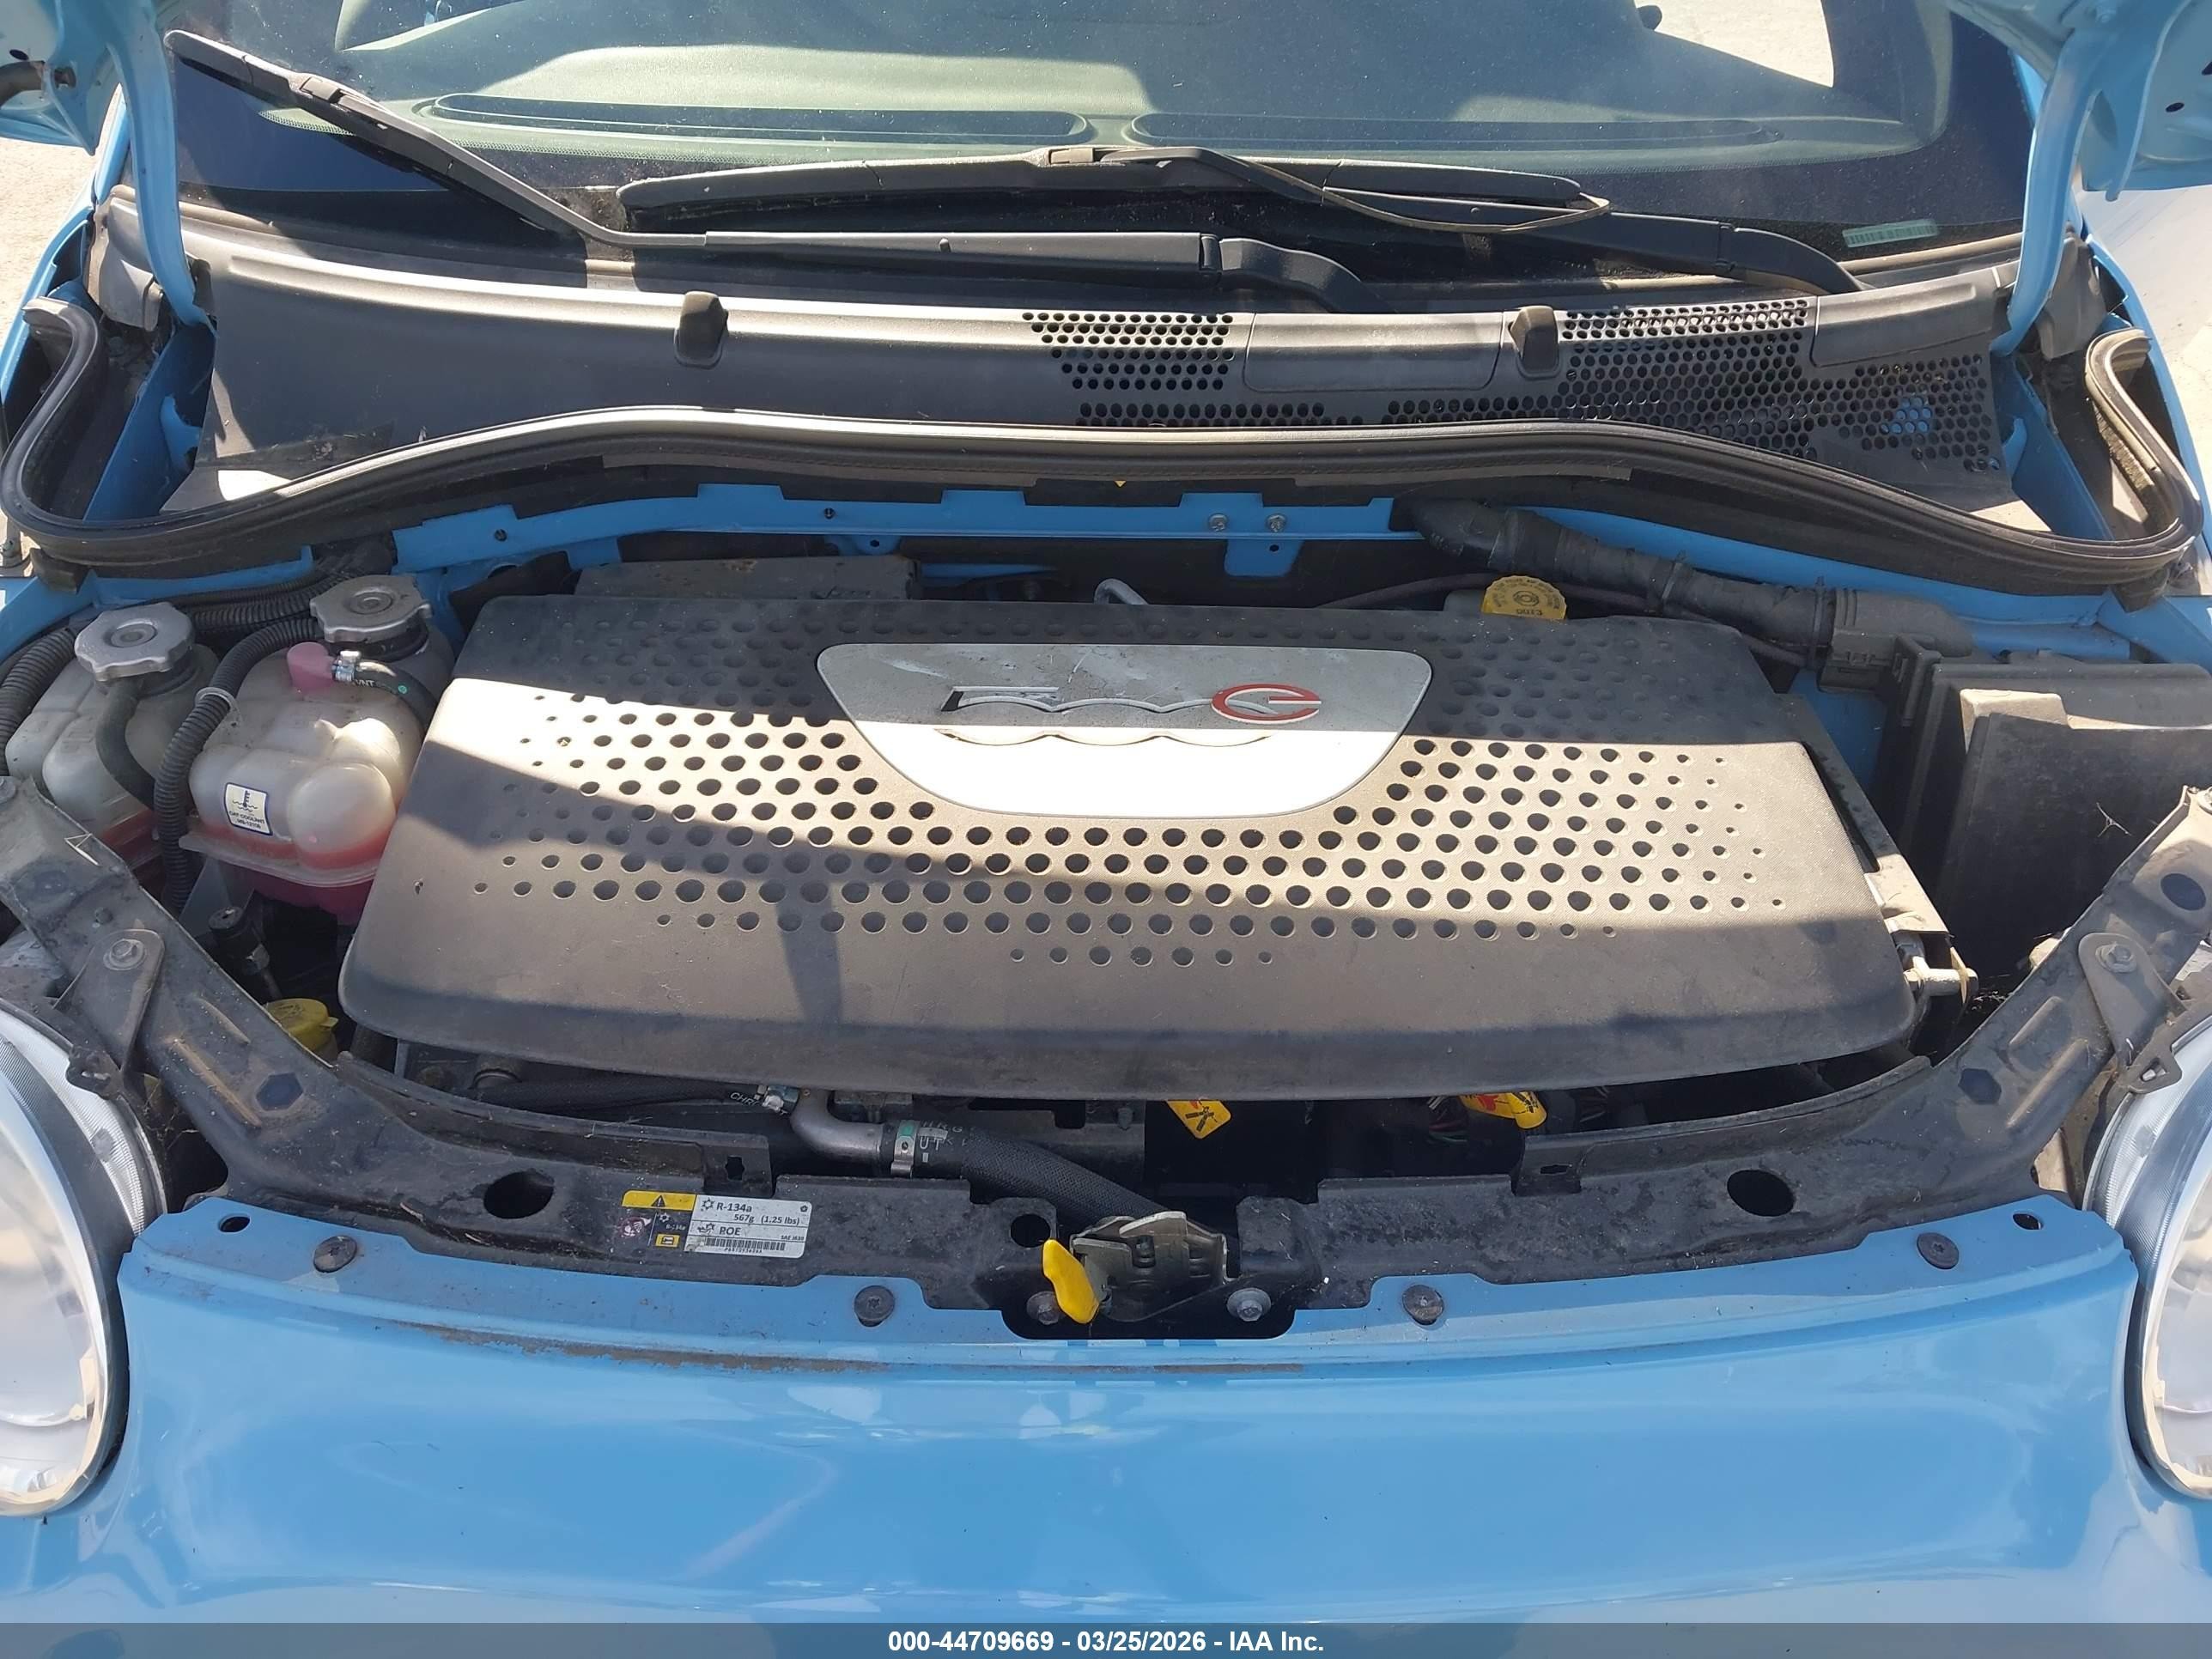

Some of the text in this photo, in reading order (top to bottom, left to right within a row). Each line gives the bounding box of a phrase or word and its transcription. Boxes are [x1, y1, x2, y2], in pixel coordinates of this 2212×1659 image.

[716, 1202, 752, 1212] R-134a
[733, 1213, 755, 1224] 567g
[761, 1213, 782, 1224] (1.25
[719, 1226, 741, 1237] POE
